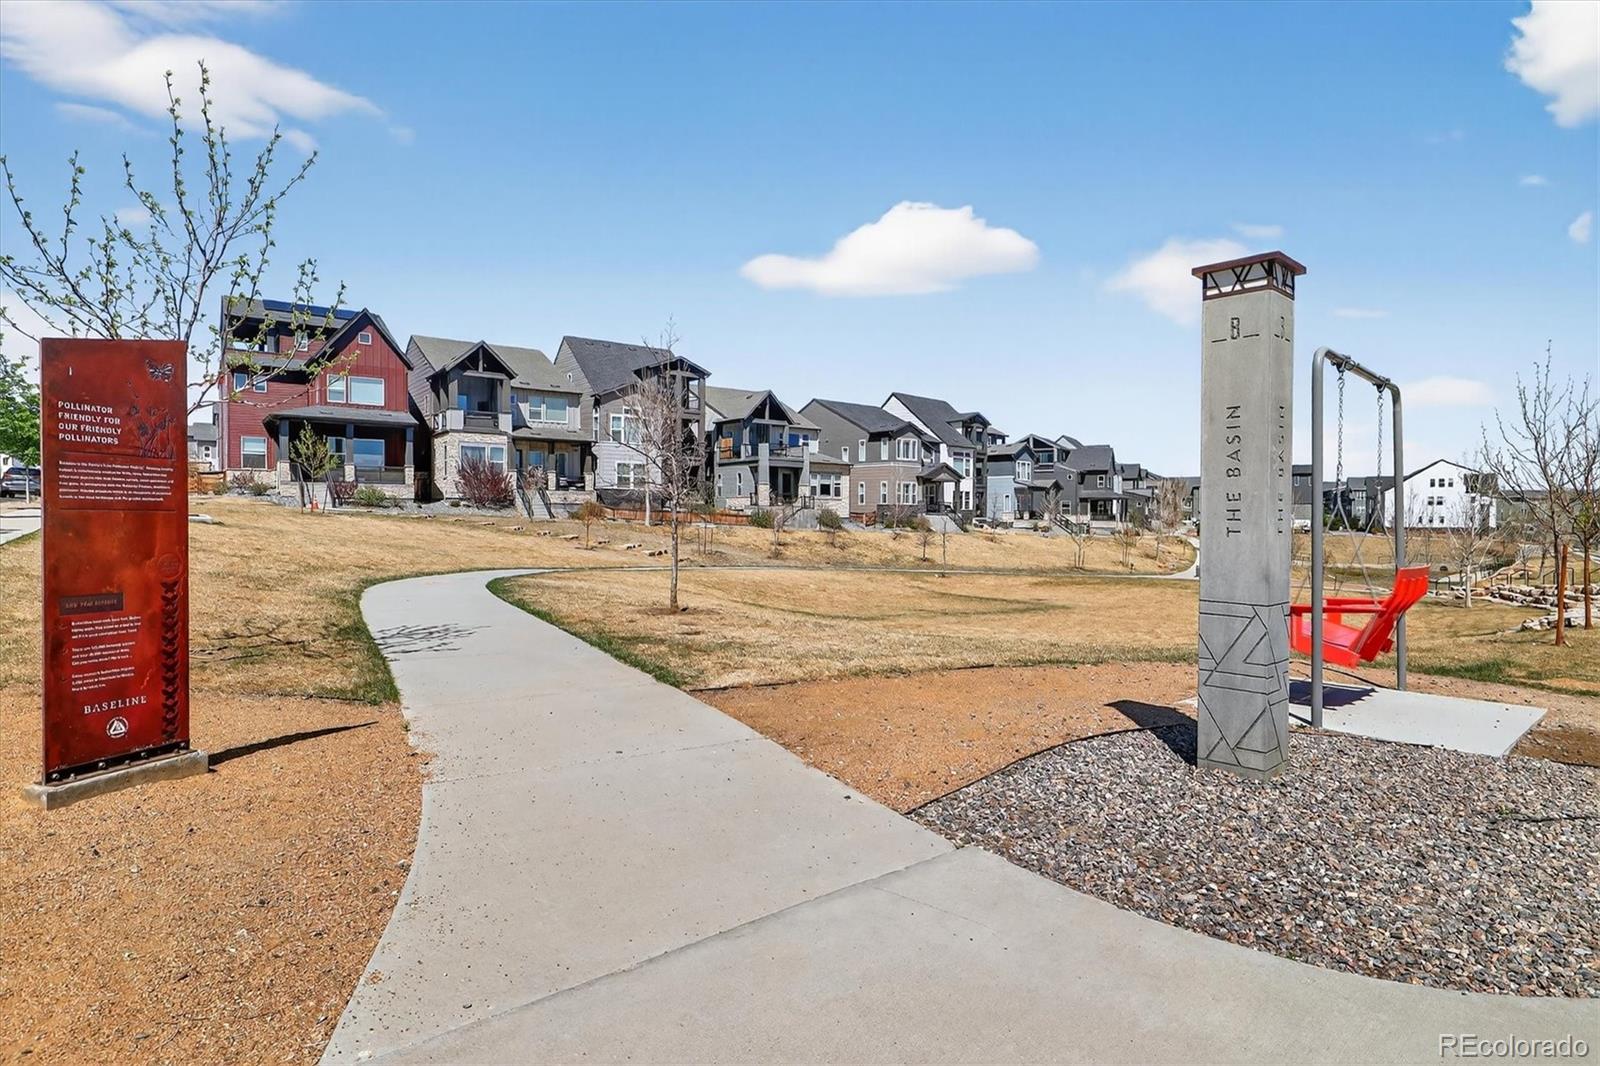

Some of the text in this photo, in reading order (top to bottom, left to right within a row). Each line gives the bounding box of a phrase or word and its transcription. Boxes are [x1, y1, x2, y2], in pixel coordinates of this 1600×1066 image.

[58, 400, 113, 414] POLLINATOR
[58, 412, 121, 425] FRIENDLY FOR
[58, 422, 121, 435] OUR FRIENDLY
[58, 432, 119, 445] POLLINATORS
[1226, 405, 1241, 537] THE BASIN
[83, 695, 148, 714] BASELINE
